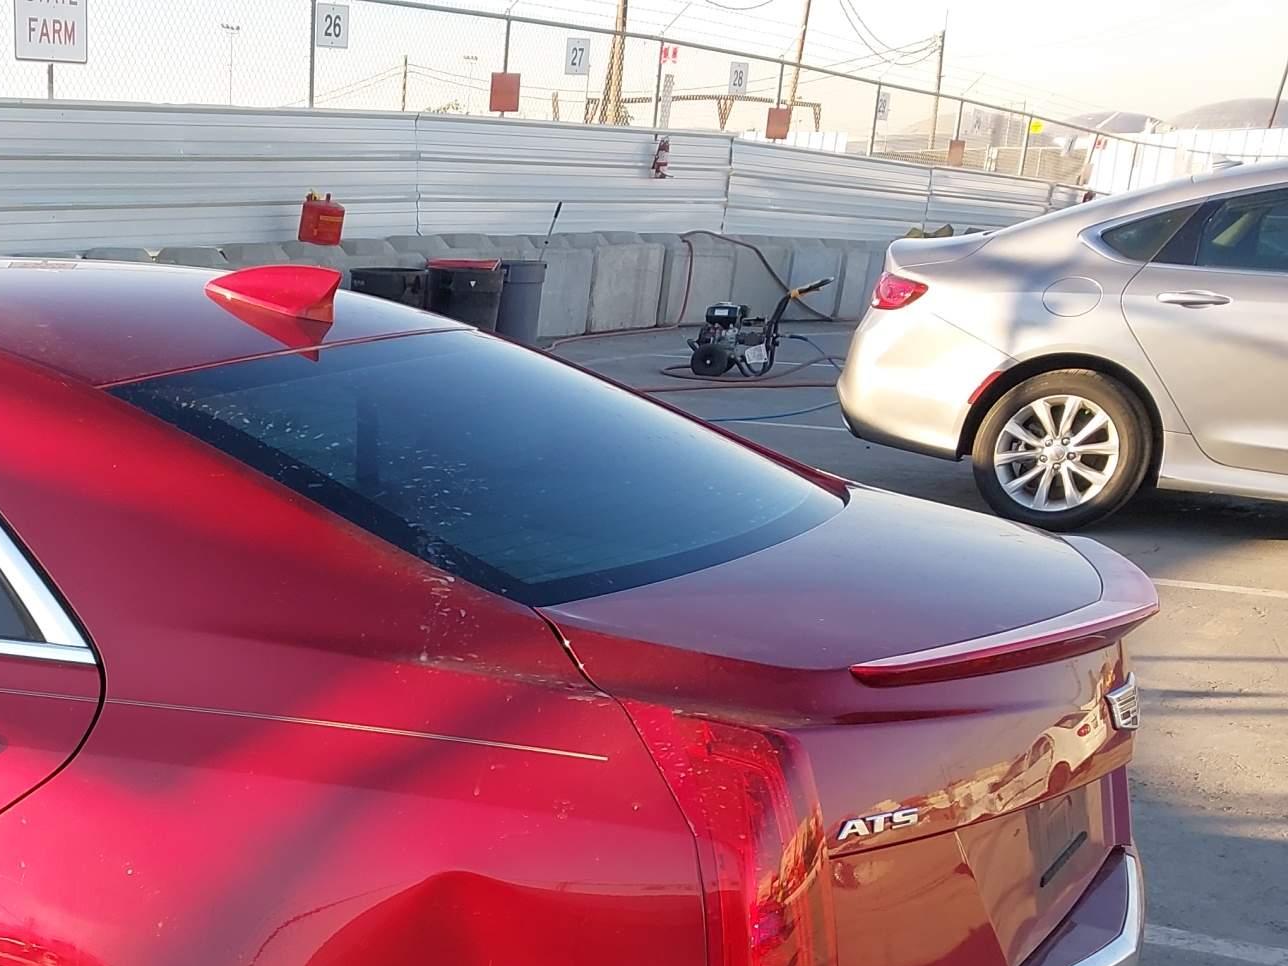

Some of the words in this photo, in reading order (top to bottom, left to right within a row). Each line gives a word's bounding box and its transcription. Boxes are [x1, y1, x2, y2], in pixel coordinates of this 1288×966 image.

[28, 16, 76, 46] FARM
[324, 14, 342, 38] 26
[571, 47, 585, 68] 27
[732, 70, 744, 88] 28
[837, 807, 920, 841] ATS
